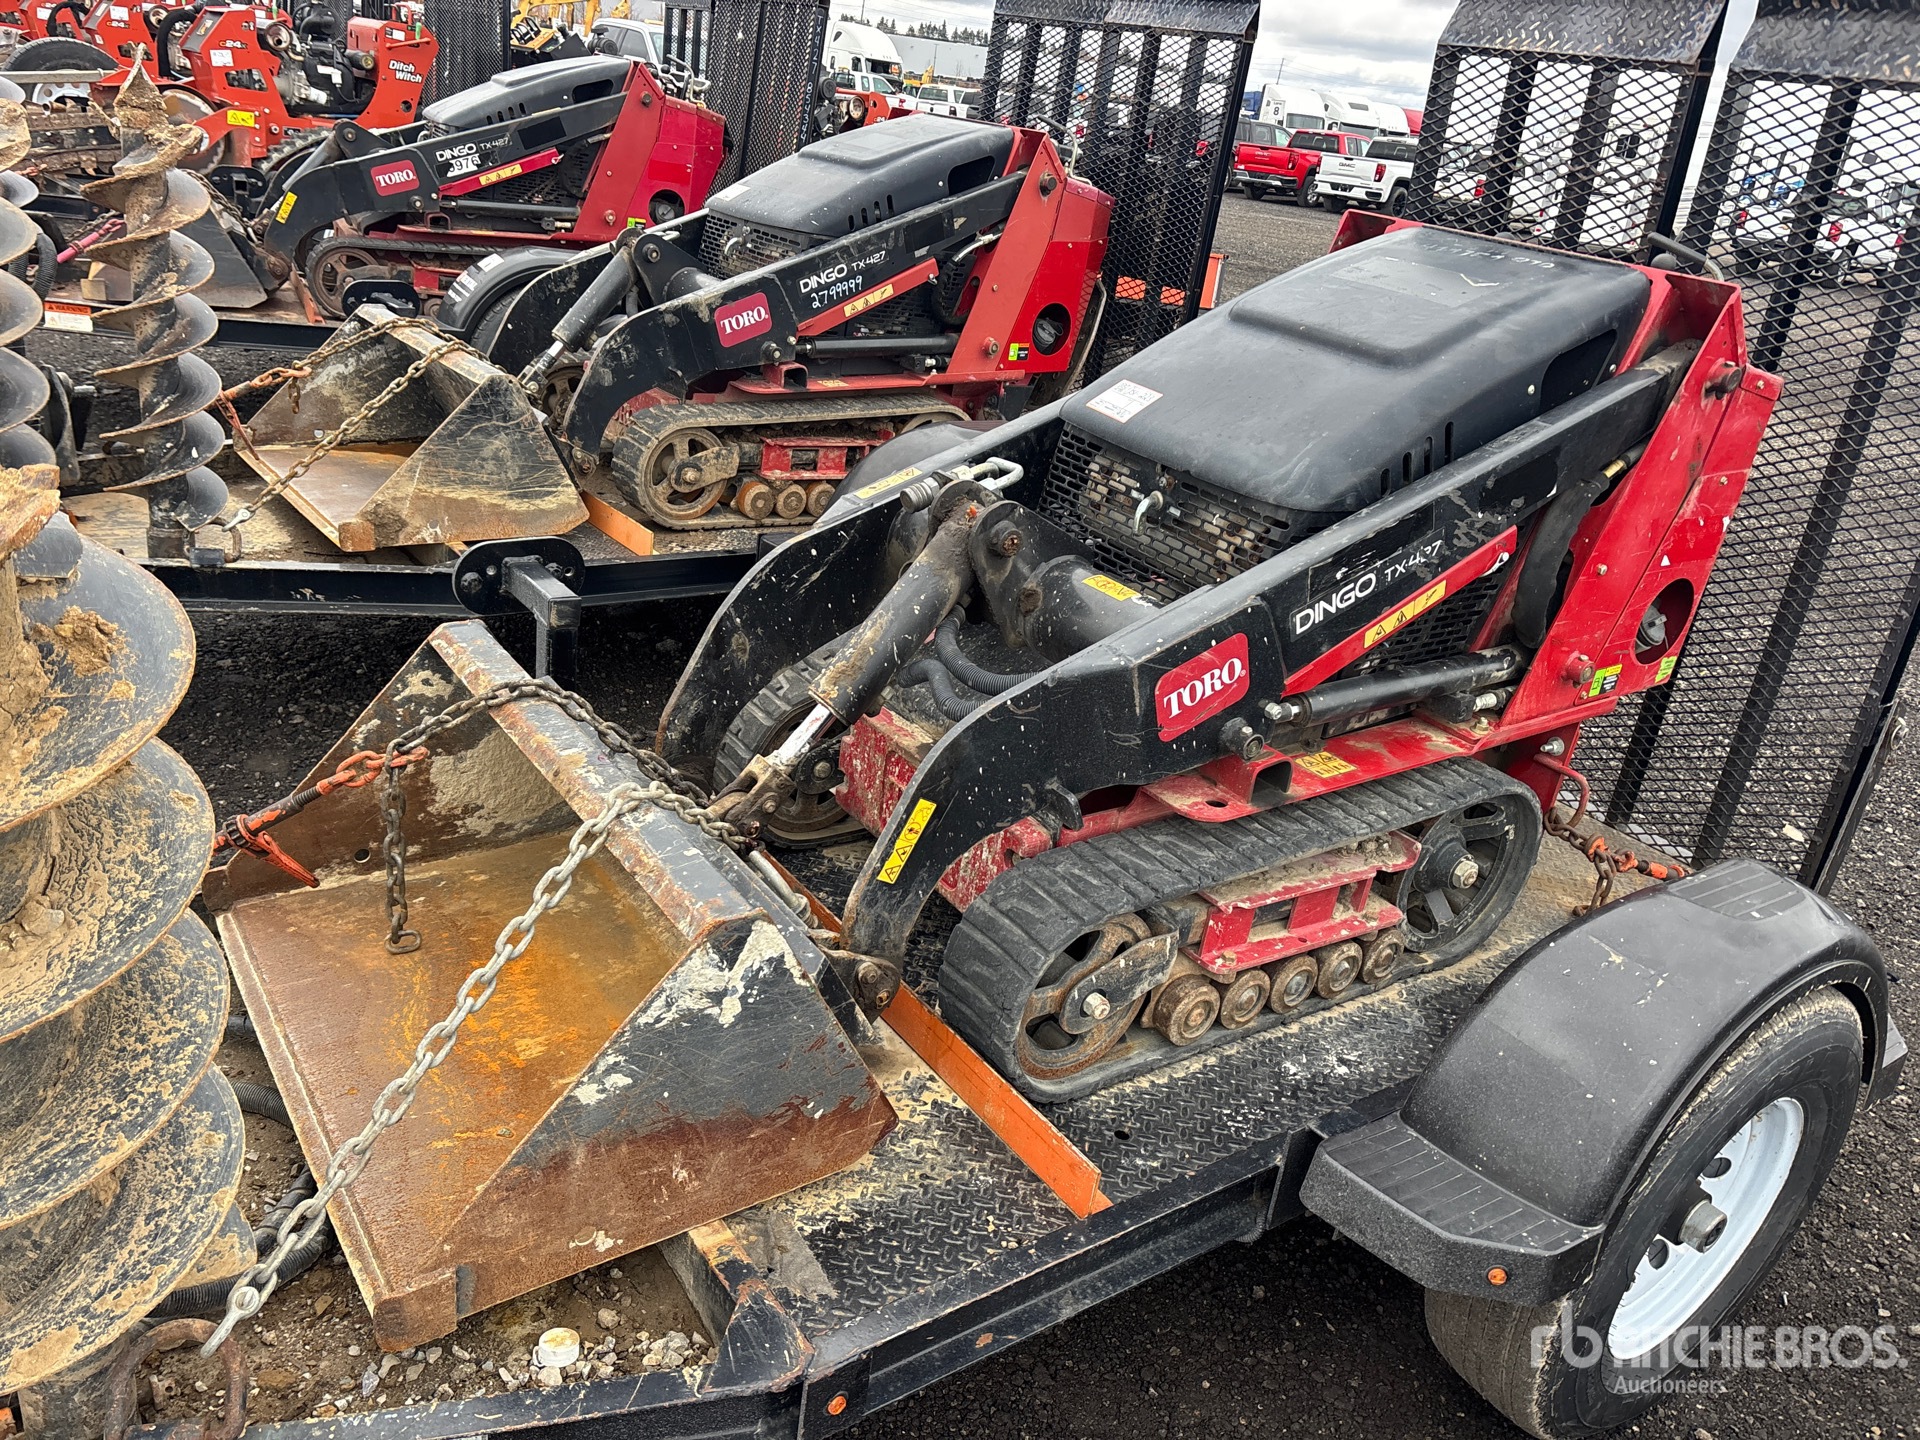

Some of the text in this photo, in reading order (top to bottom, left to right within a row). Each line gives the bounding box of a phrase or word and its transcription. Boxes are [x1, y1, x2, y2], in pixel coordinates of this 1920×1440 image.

[389, 60, 415, 73] Ditch
[395, 70, 423, 83] Witch
[1273, 106, 1280, 116] 8
[435, 143, 477, 161] DINGO
[1338, 161, 1356, 169] GMC
[375, 169, 415, 187] TORO
[799, 263, 848, 294] DINGO
[810, 275, 863, 309] 2799999
[720, 306, 766, 335] TORO
[1296, 573, 1377, 635] DINGO
[1163, 657, 1243, 719] TORO
